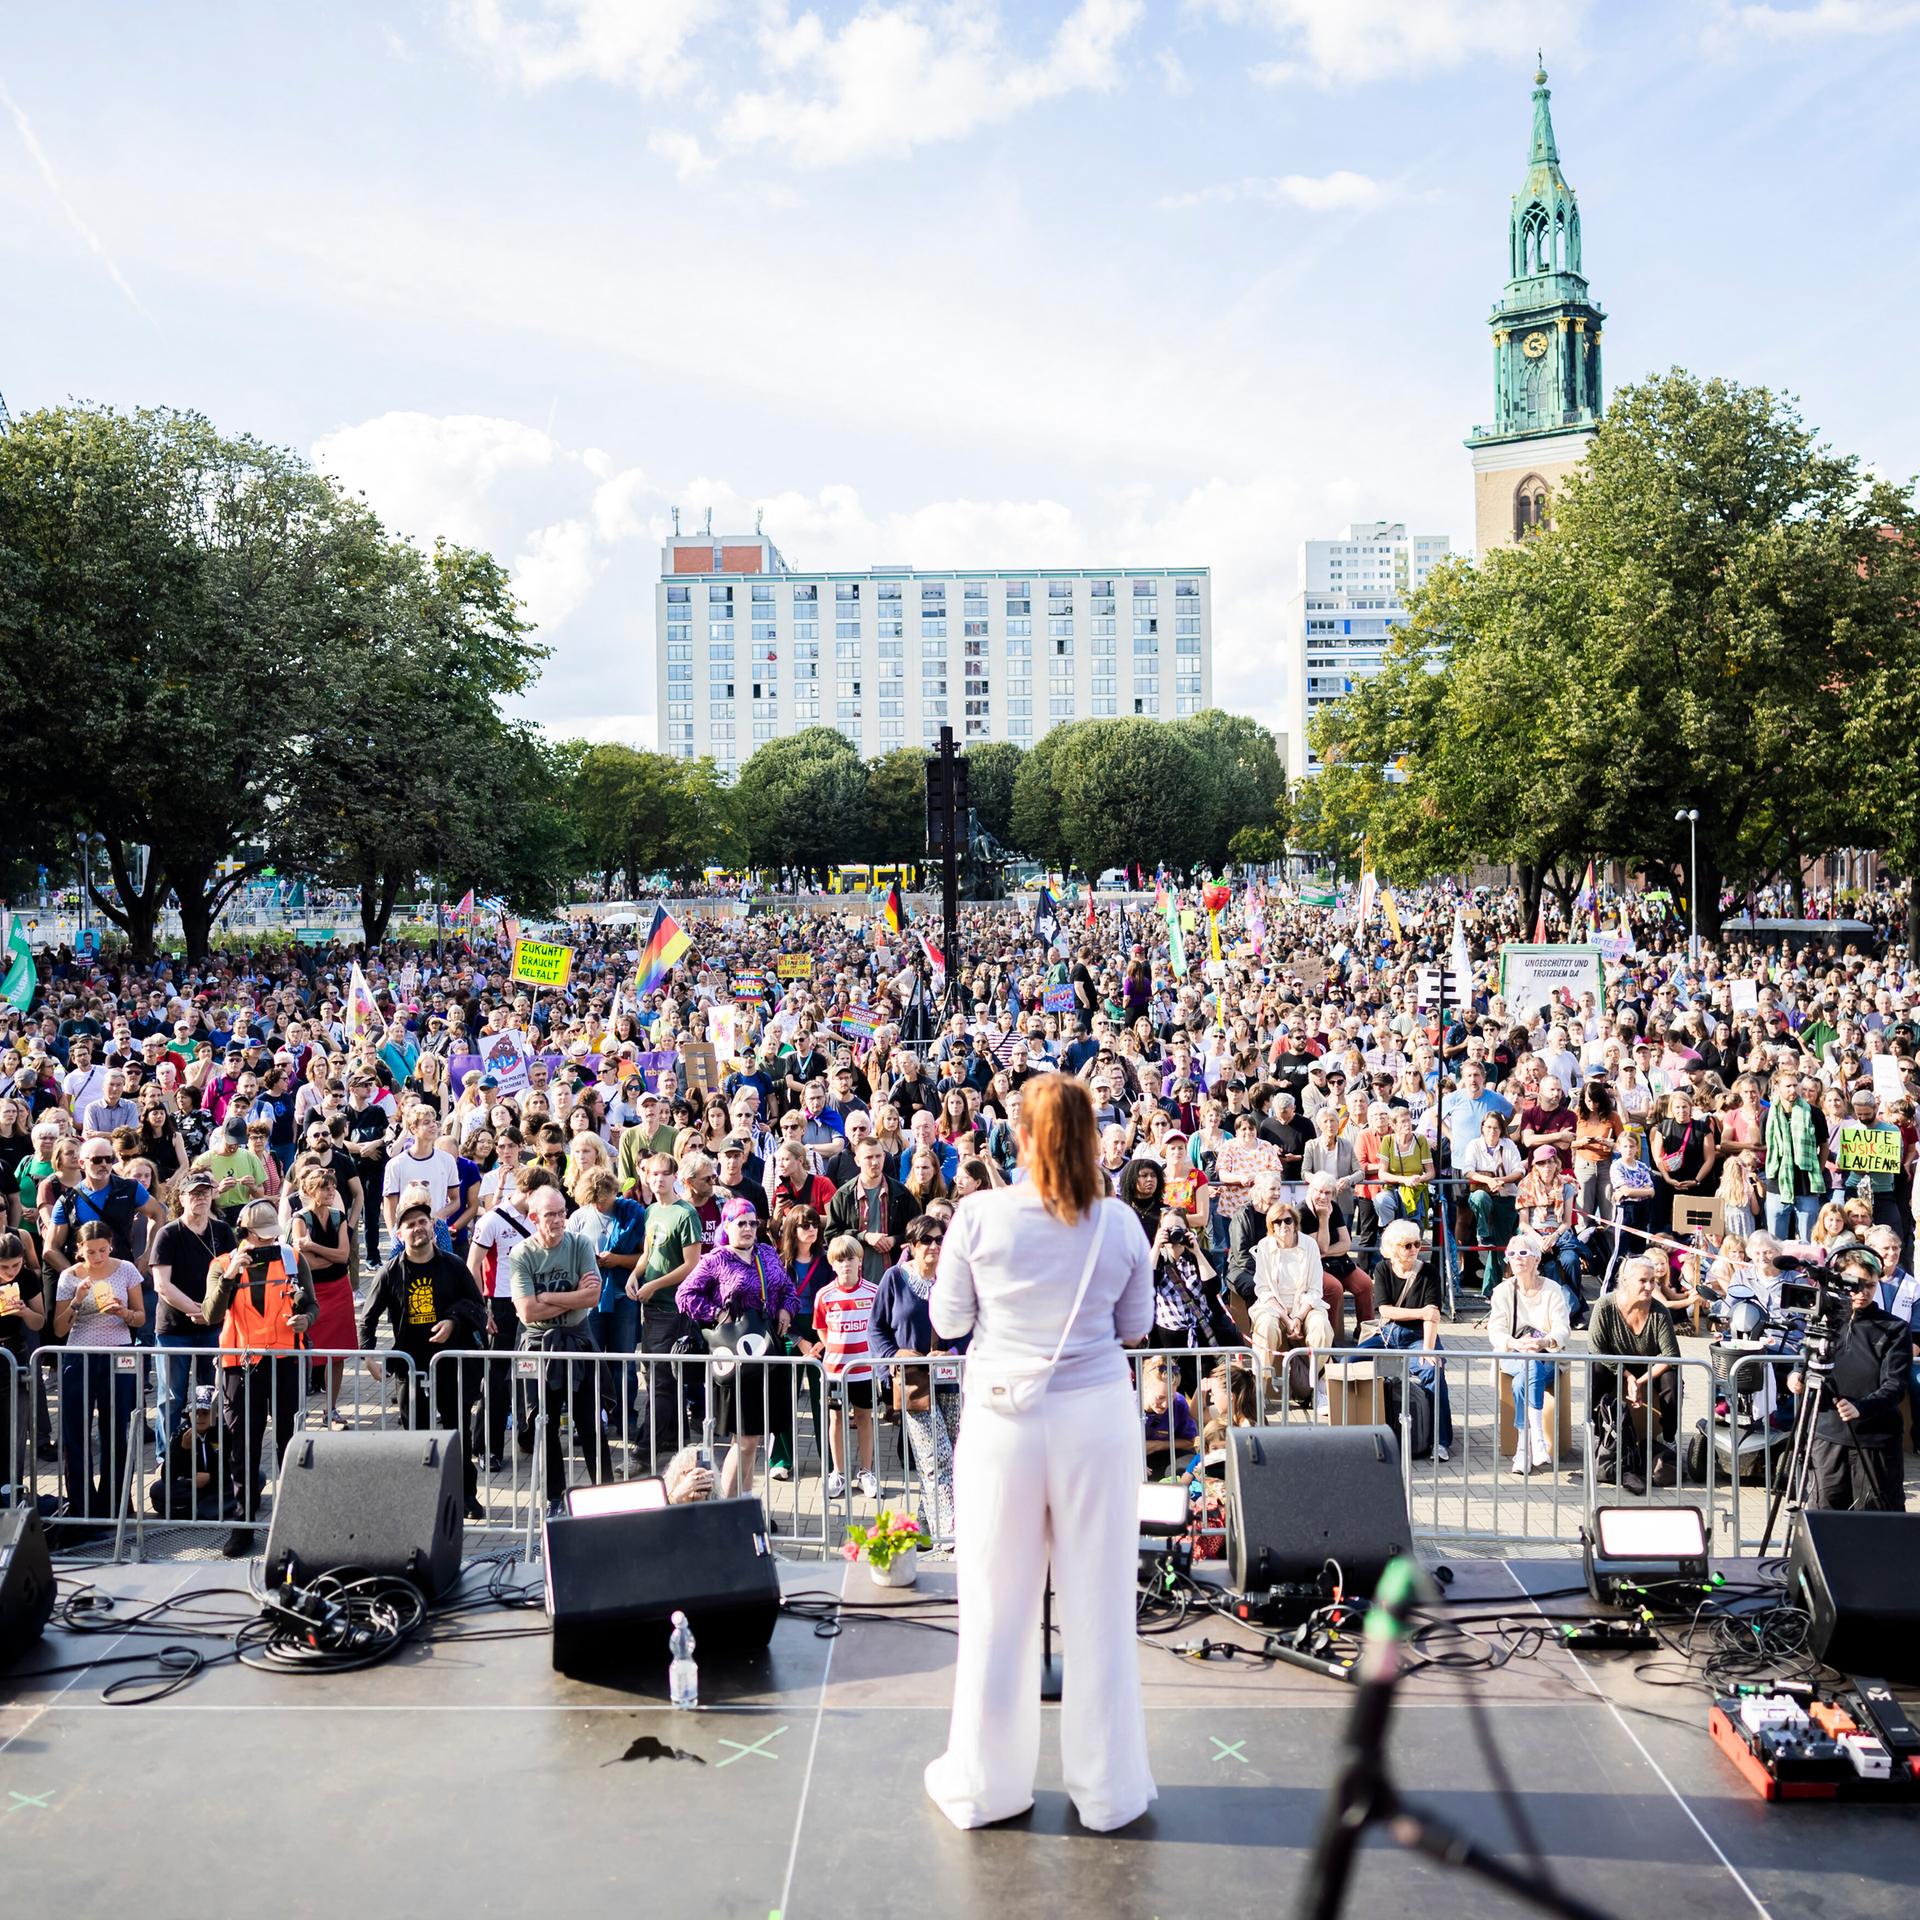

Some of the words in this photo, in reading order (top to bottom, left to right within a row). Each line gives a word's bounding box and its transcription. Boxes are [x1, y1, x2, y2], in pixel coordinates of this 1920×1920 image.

[521, 943, 565, 957] ZUKUNFT
[522, 955, 560, 969] BRAUCHT
[1525, 958, 1572, 967] UNGESCHÜTZT
[1574, 959, 1589, 967] UND
[518, 968, 559, 980] VIELFALT
[1533, 969, 1568, 977] TROTZDEM
[1842, 1129, 1893, 1144] LAUTE
[1842, 1143, 1877, 1155] MUSIK
[1879, 1145, 1899, 1155] STATT
[1843, 1155, 1882, 1169] LAUTE
[706, 1220, 716, 1230] IST
[548, 1267, 568, 1281] too
[840, 1319, 867, 1331] raisin
